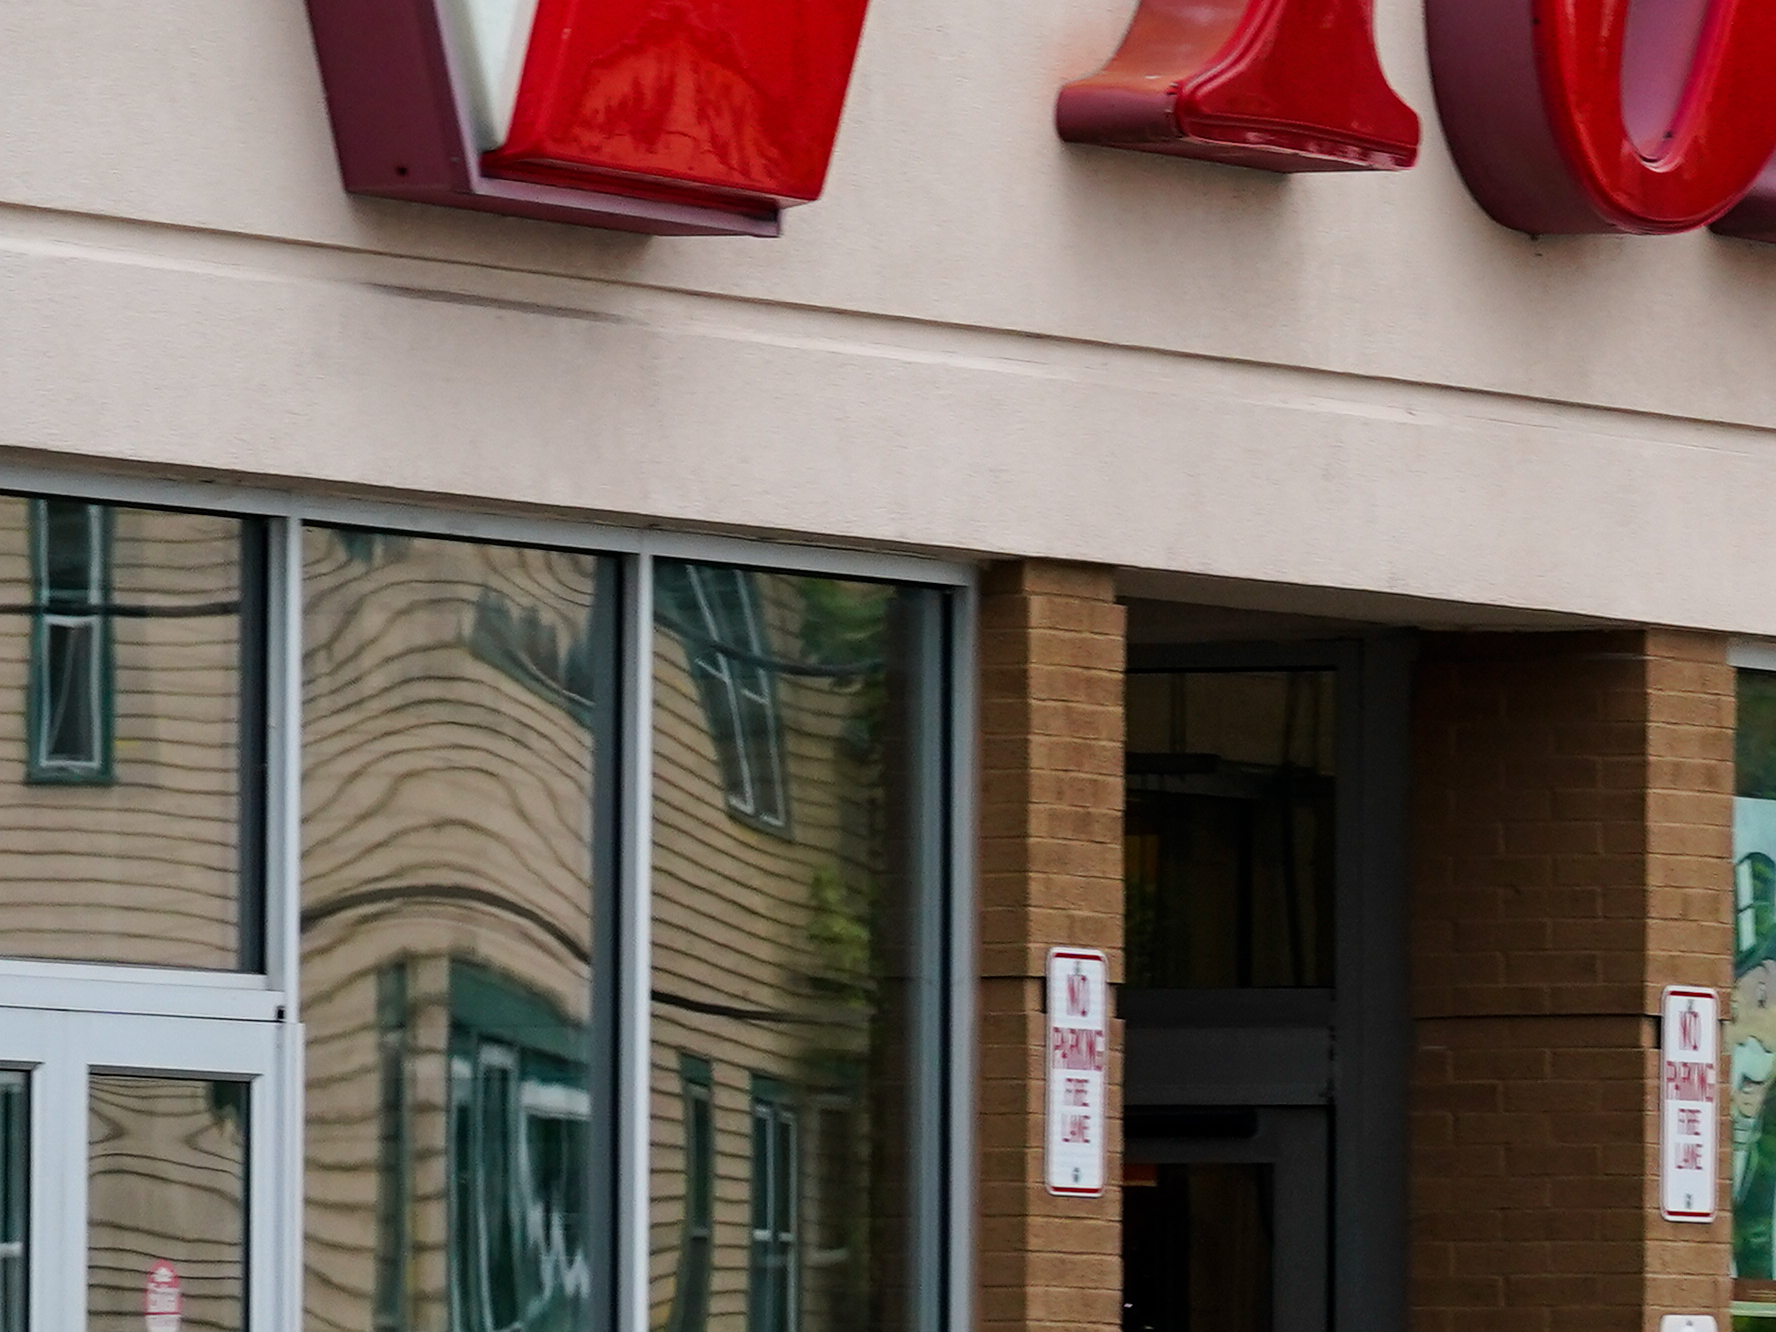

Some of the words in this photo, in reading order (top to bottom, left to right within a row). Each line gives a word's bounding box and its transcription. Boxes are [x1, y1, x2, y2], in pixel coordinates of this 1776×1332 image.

[1067, 973, 1090, 1017] NO
[1053, 1027, 1104, 1072] PARKING
[1679, 1011, 1700, 1051] NO
[1666, 1061, 1714, 1102] PARKING
